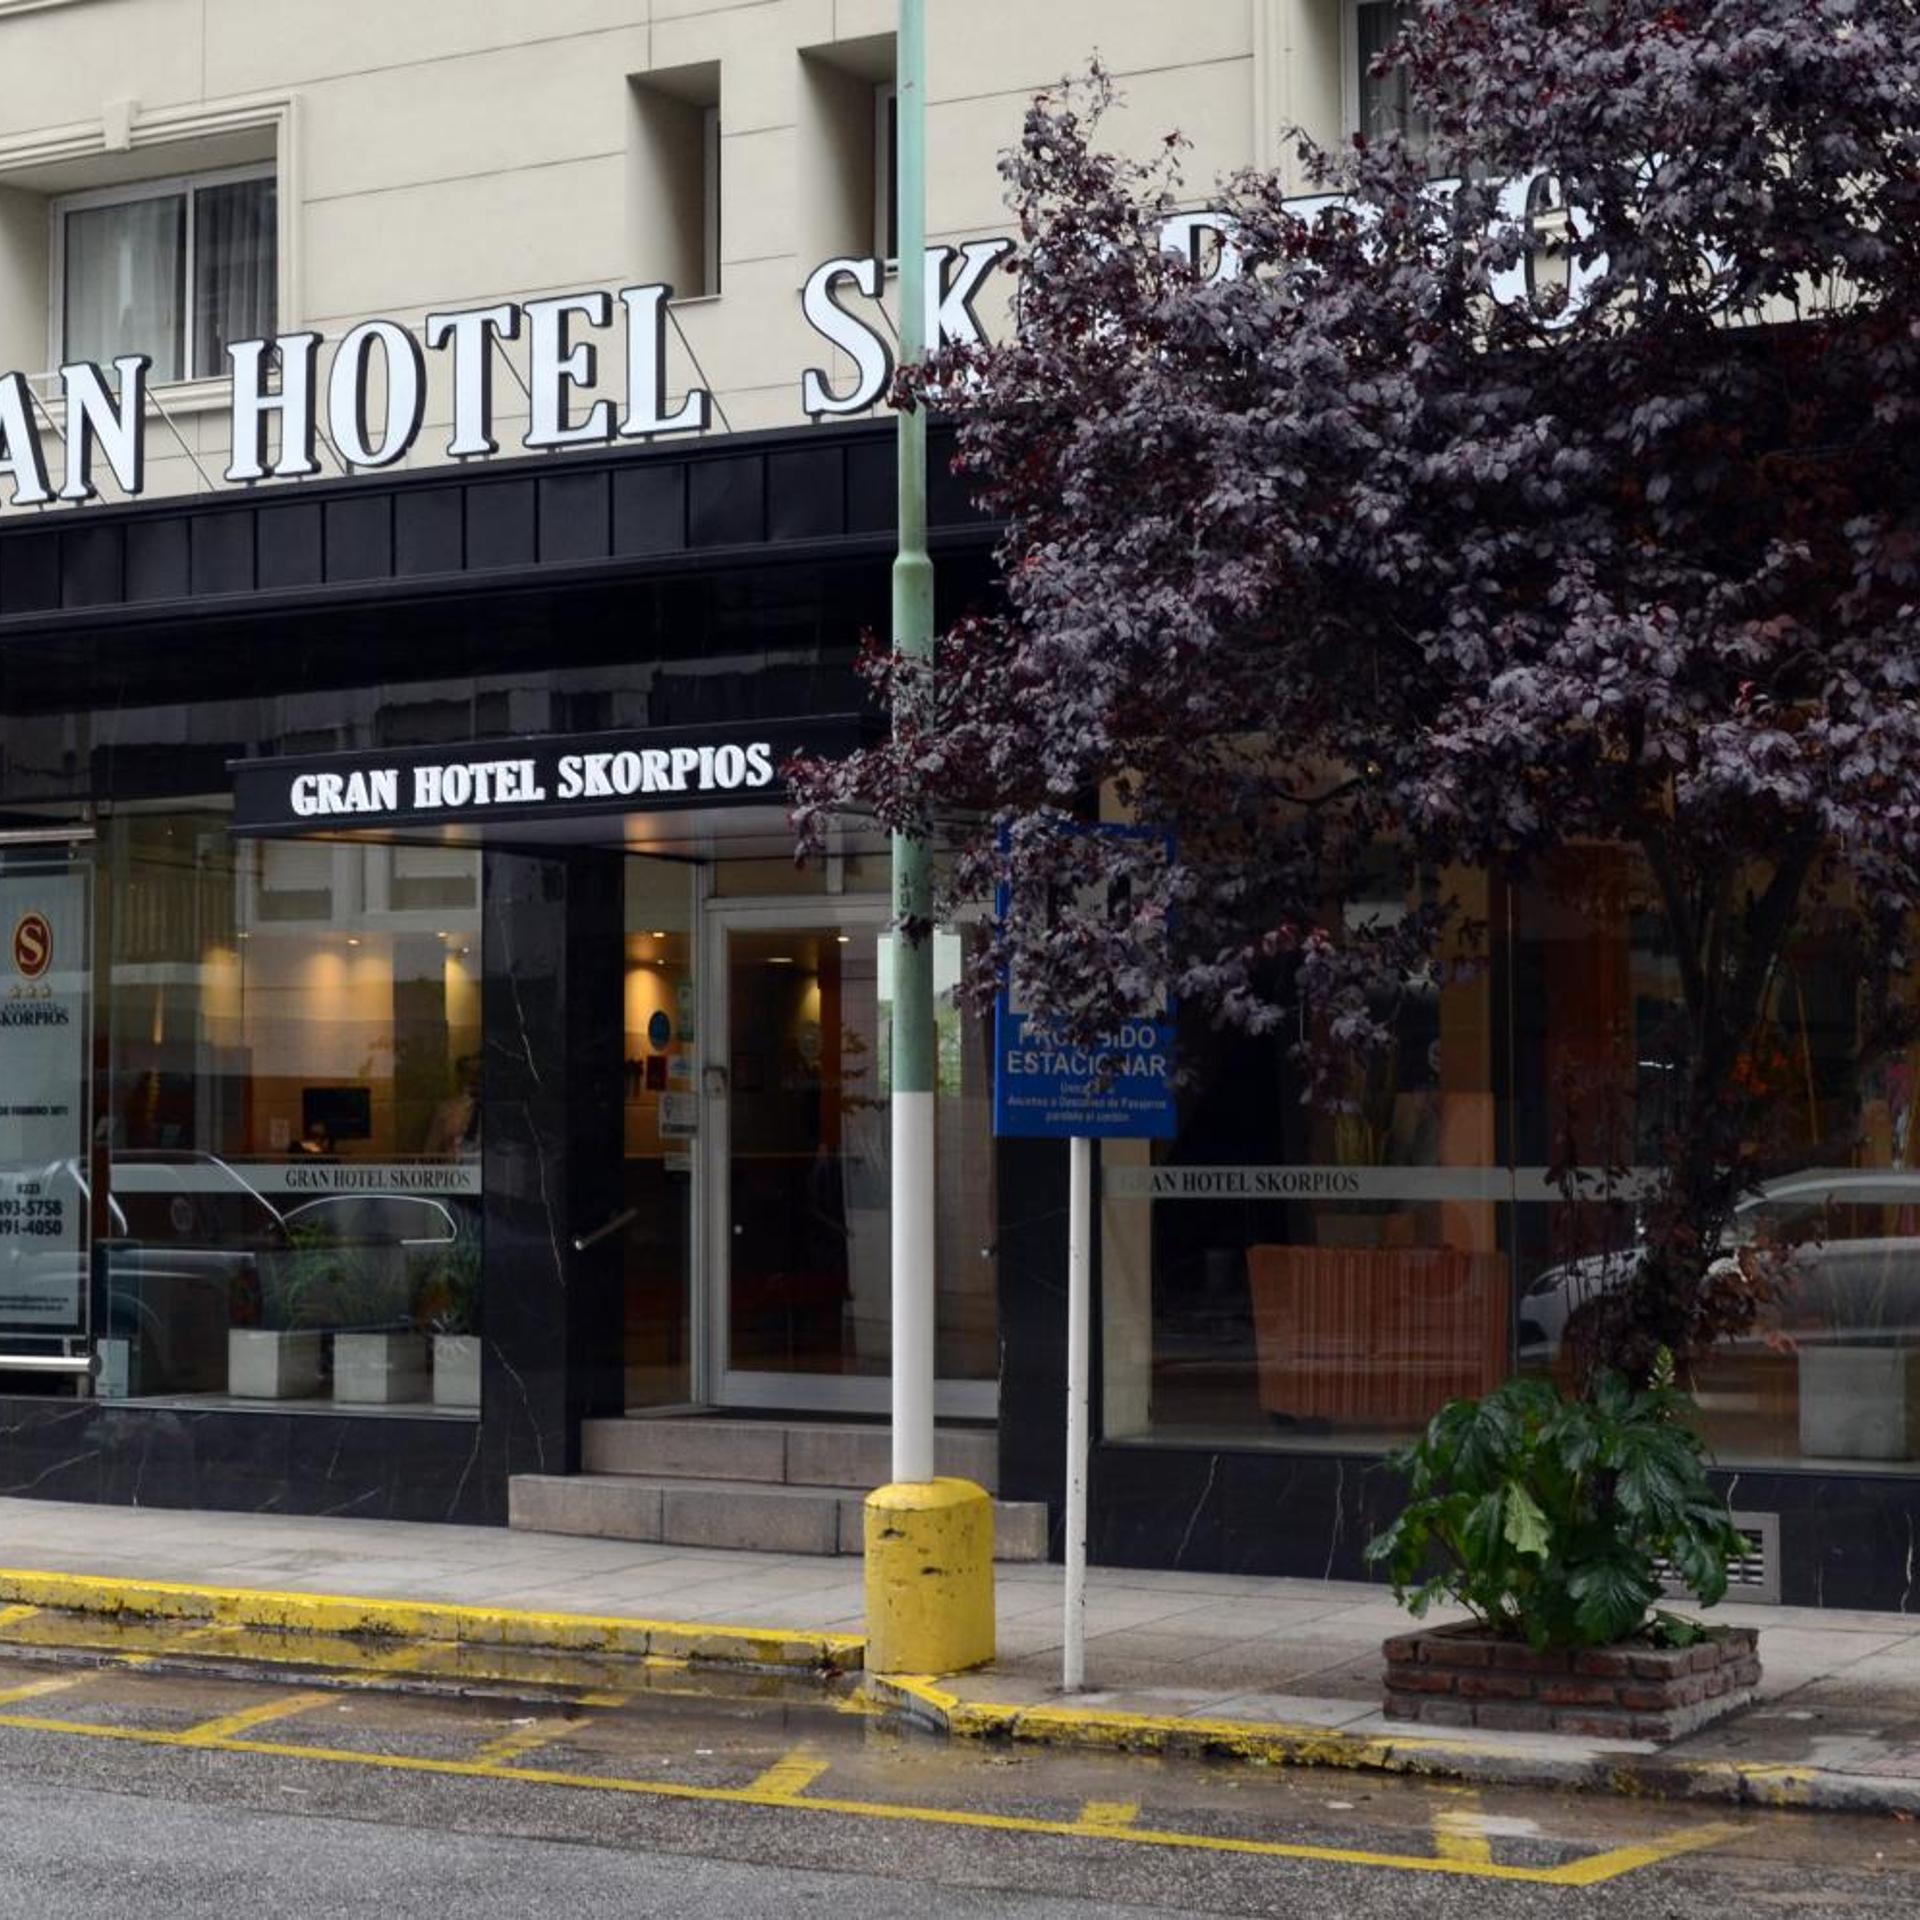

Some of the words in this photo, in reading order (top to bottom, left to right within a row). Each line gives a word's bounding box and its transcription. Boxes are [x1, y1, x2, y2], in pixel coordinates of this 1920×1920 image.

[225, 284, 711, 482] HOTEL
[291, 770, 397, 816] GRAN
[413, 760, 545, 809] HOTEL
[558, 743, 772, 798] SKORPIOS
[19, 924, 44, 965] S
[0, 1010, 69, 1027] KORPIOS
[286, 1170, 329, 1188] GRAN
[334, 1170, 387, 1188] HOTEL
[390, 1169, 470, 1188] SKORPIOS
[1182, 1171, 1251, 1193] HOTEL
[1256, 1171, 1359, 1193] SKORPIOS
